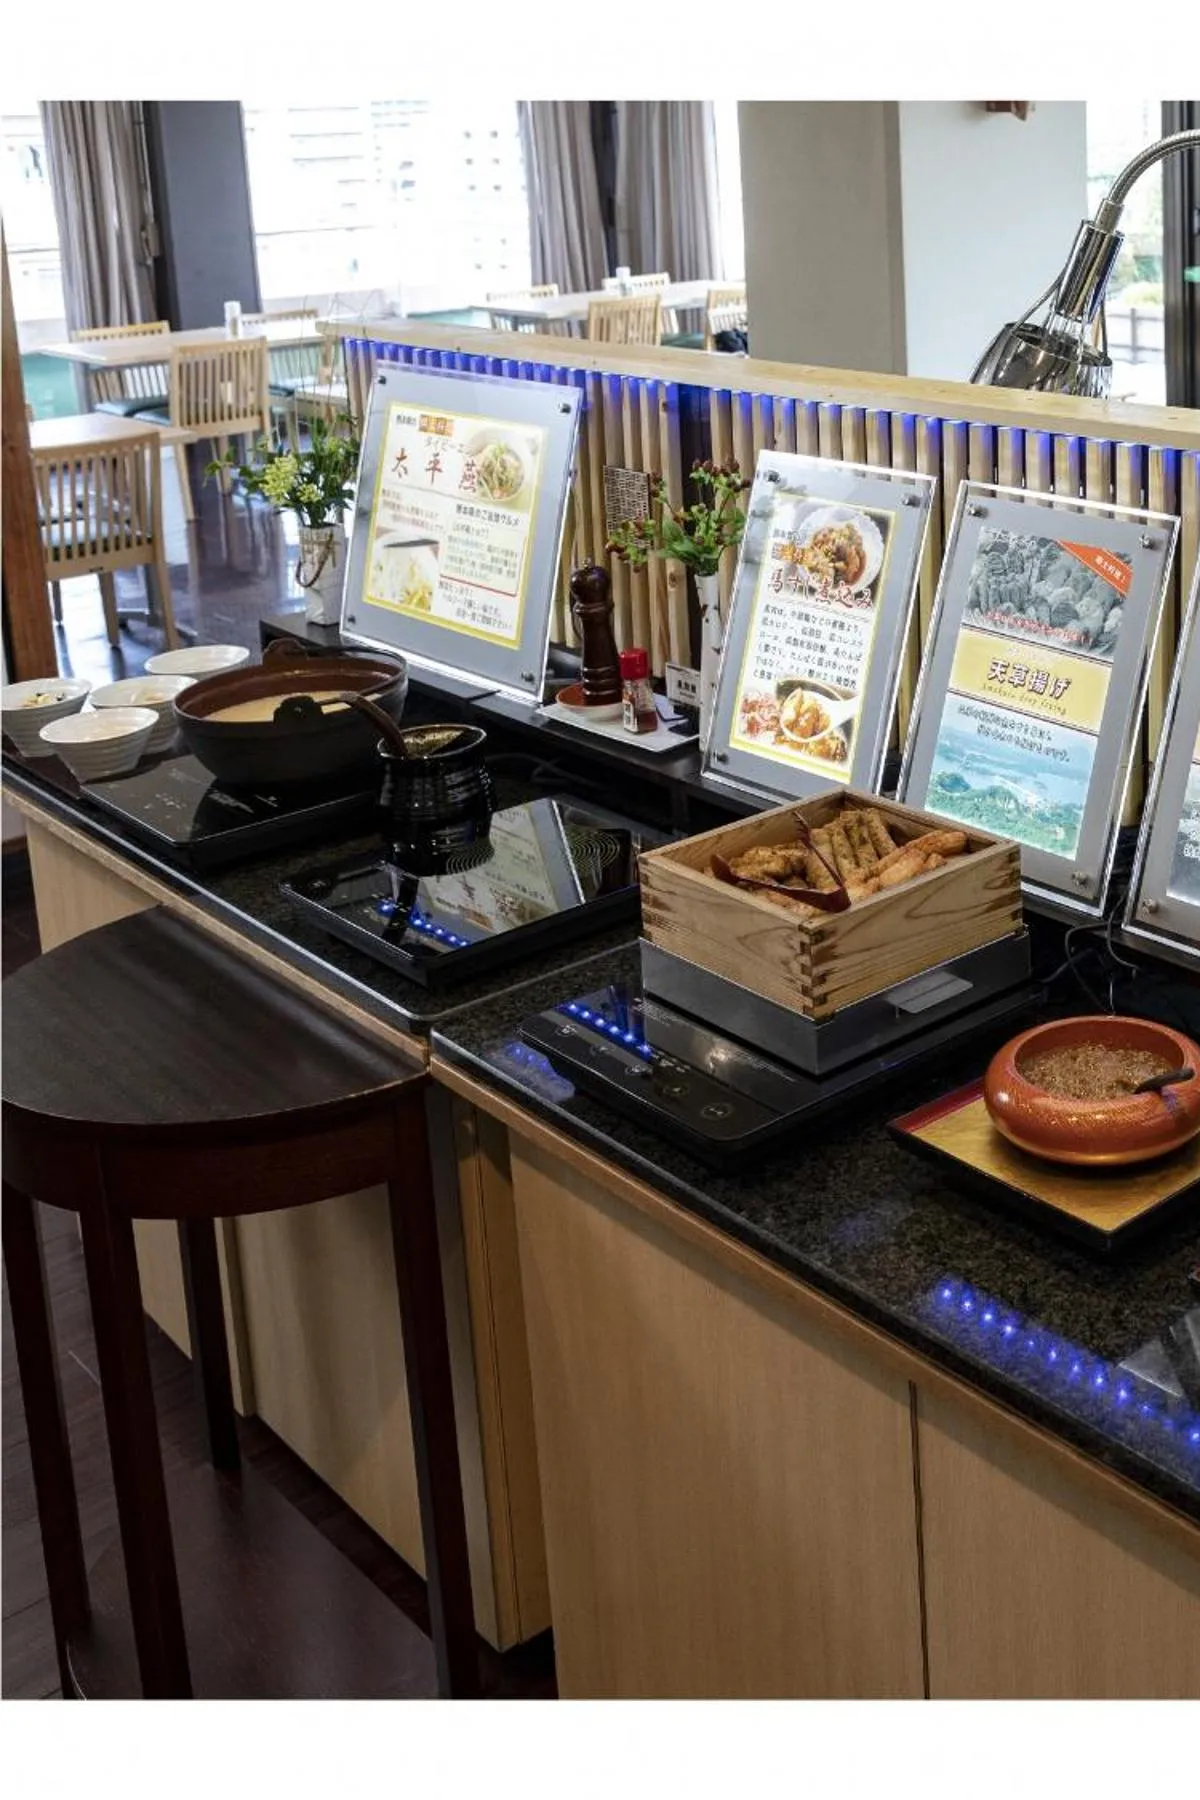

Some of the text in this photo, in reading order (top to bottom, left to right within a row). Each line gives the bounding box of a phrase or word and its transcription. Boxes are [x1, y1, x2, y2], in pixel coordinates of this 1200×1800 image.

[391, 447, 479, 491] 太平燕
[988, 659, 1071, 700] 天草揚げ
